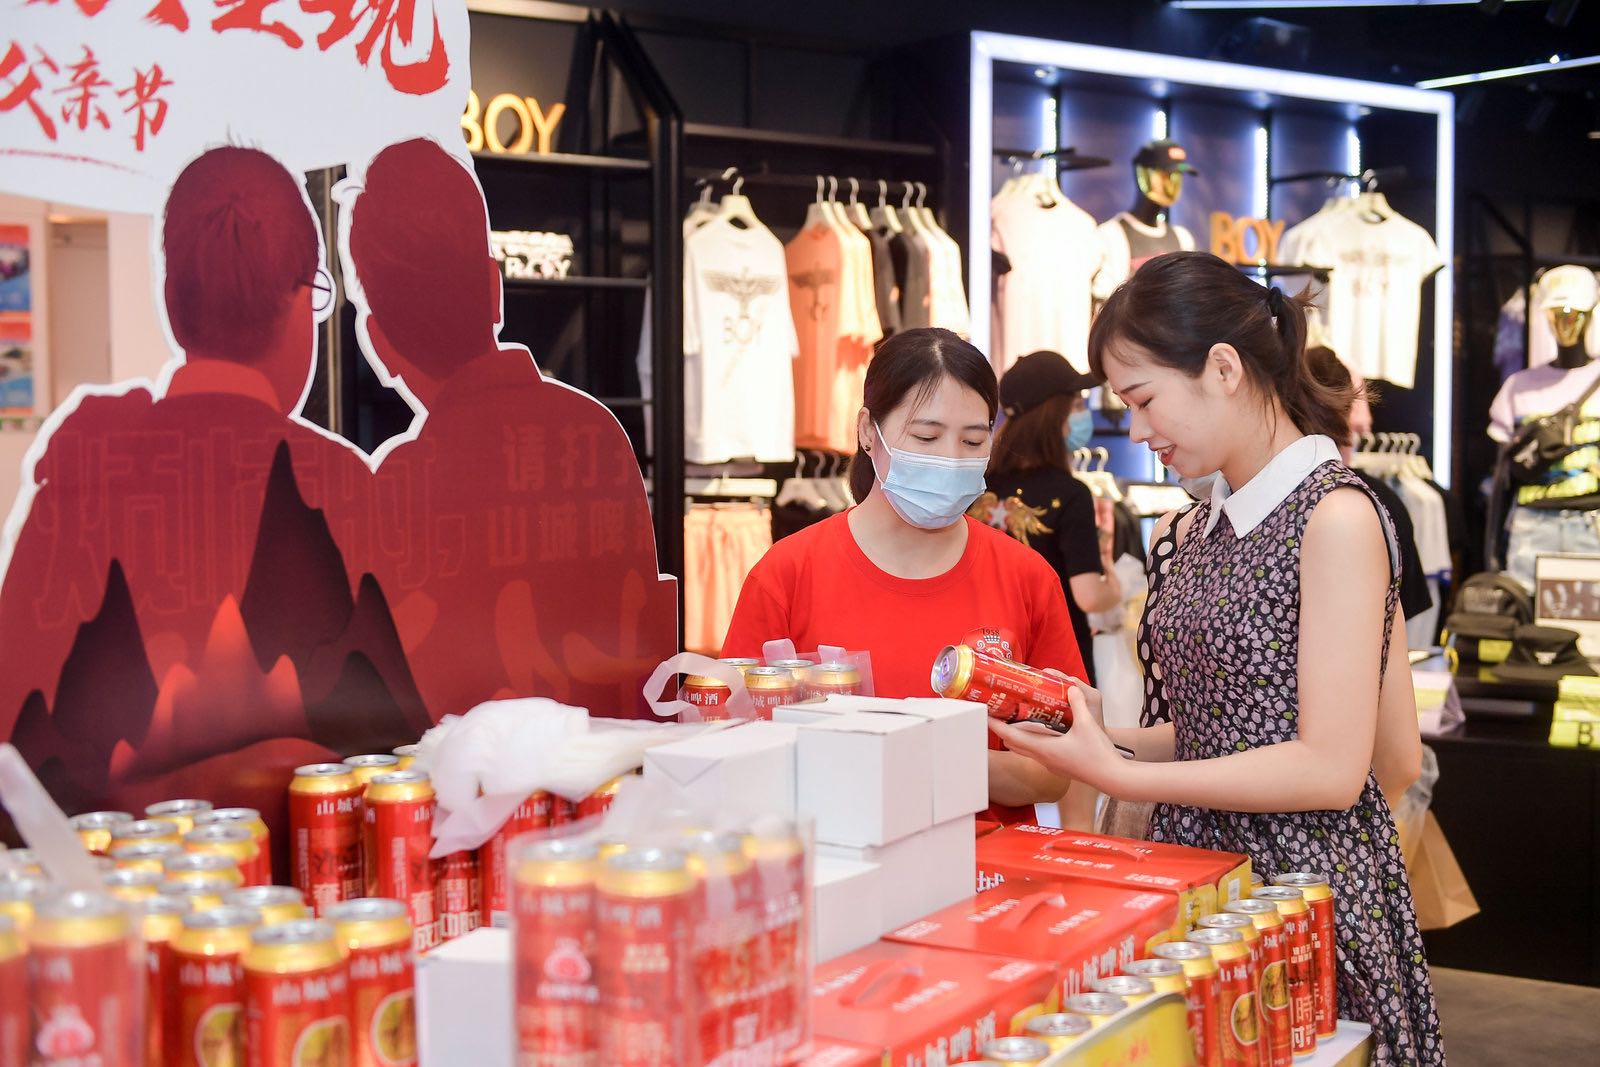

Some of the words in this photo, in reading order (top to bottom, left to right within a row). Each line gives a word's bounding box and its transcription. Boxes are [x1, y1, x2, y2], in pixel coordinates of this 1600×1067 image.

[0, 40, 174, 152] 父亲节
[460, 89, 566, 155] BOY
[1209, 211, 1285, 267] BOY
